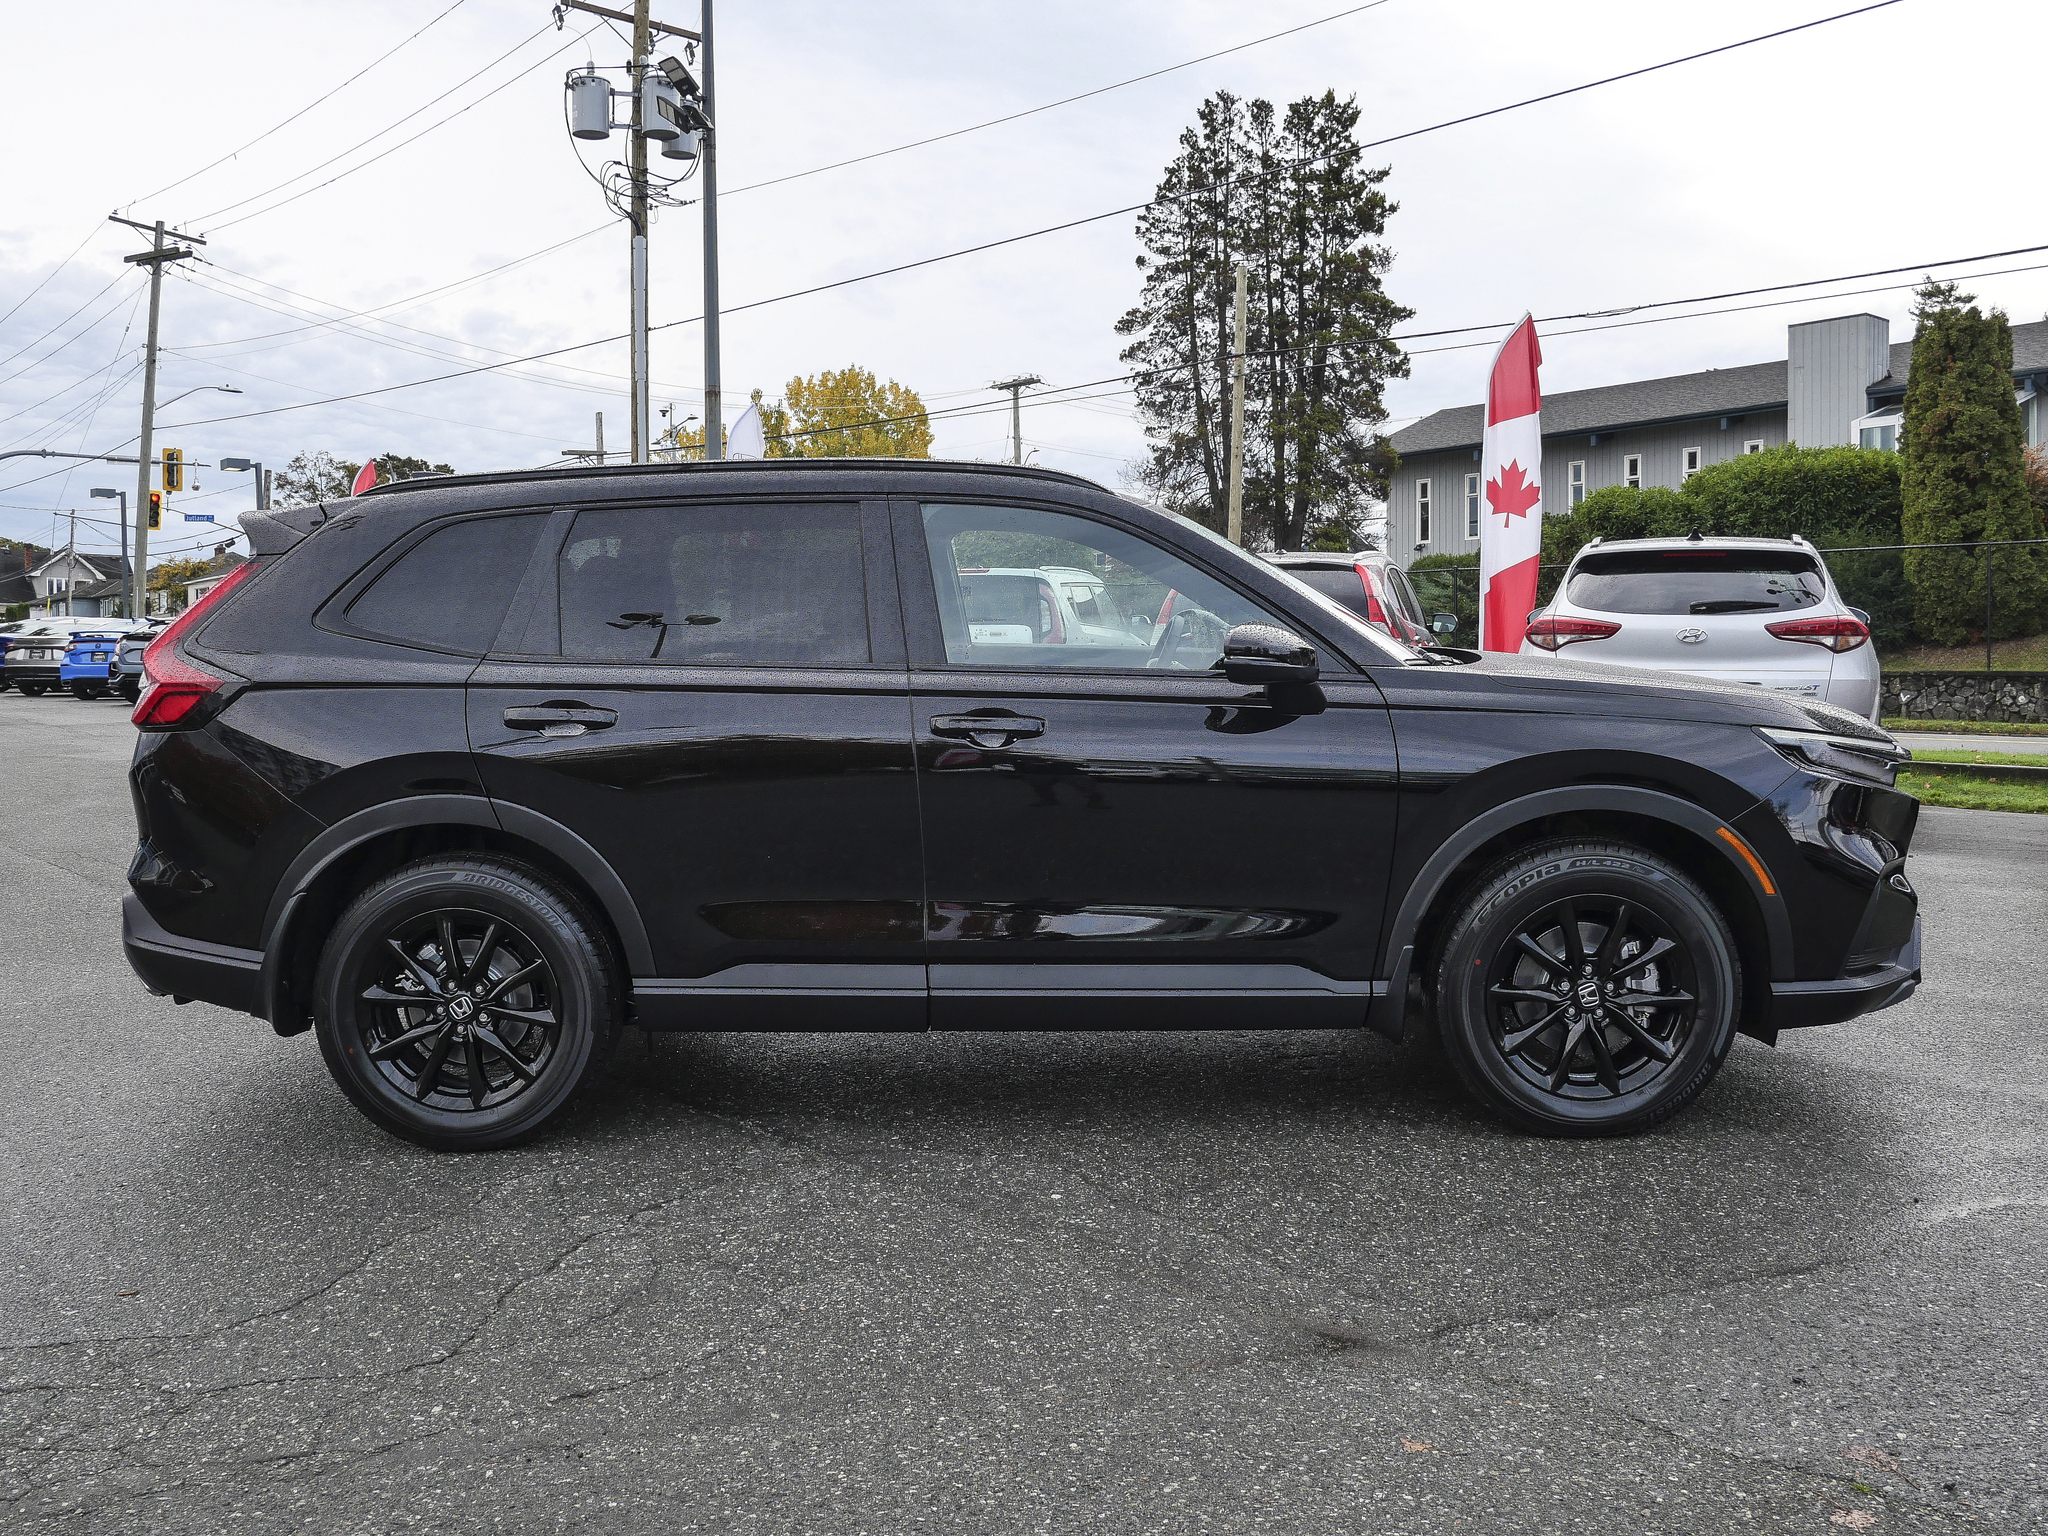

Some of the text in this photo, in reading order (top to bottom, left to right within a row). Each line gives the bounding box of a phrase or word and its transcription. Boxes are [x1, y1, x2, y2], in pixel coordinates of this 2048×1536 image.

[1602, 860, 1631, 869] 422
[462, 873, 565, 932] BRIDGESTONE
[1630, 1061, 1712, 1125] BRIDGESTO
